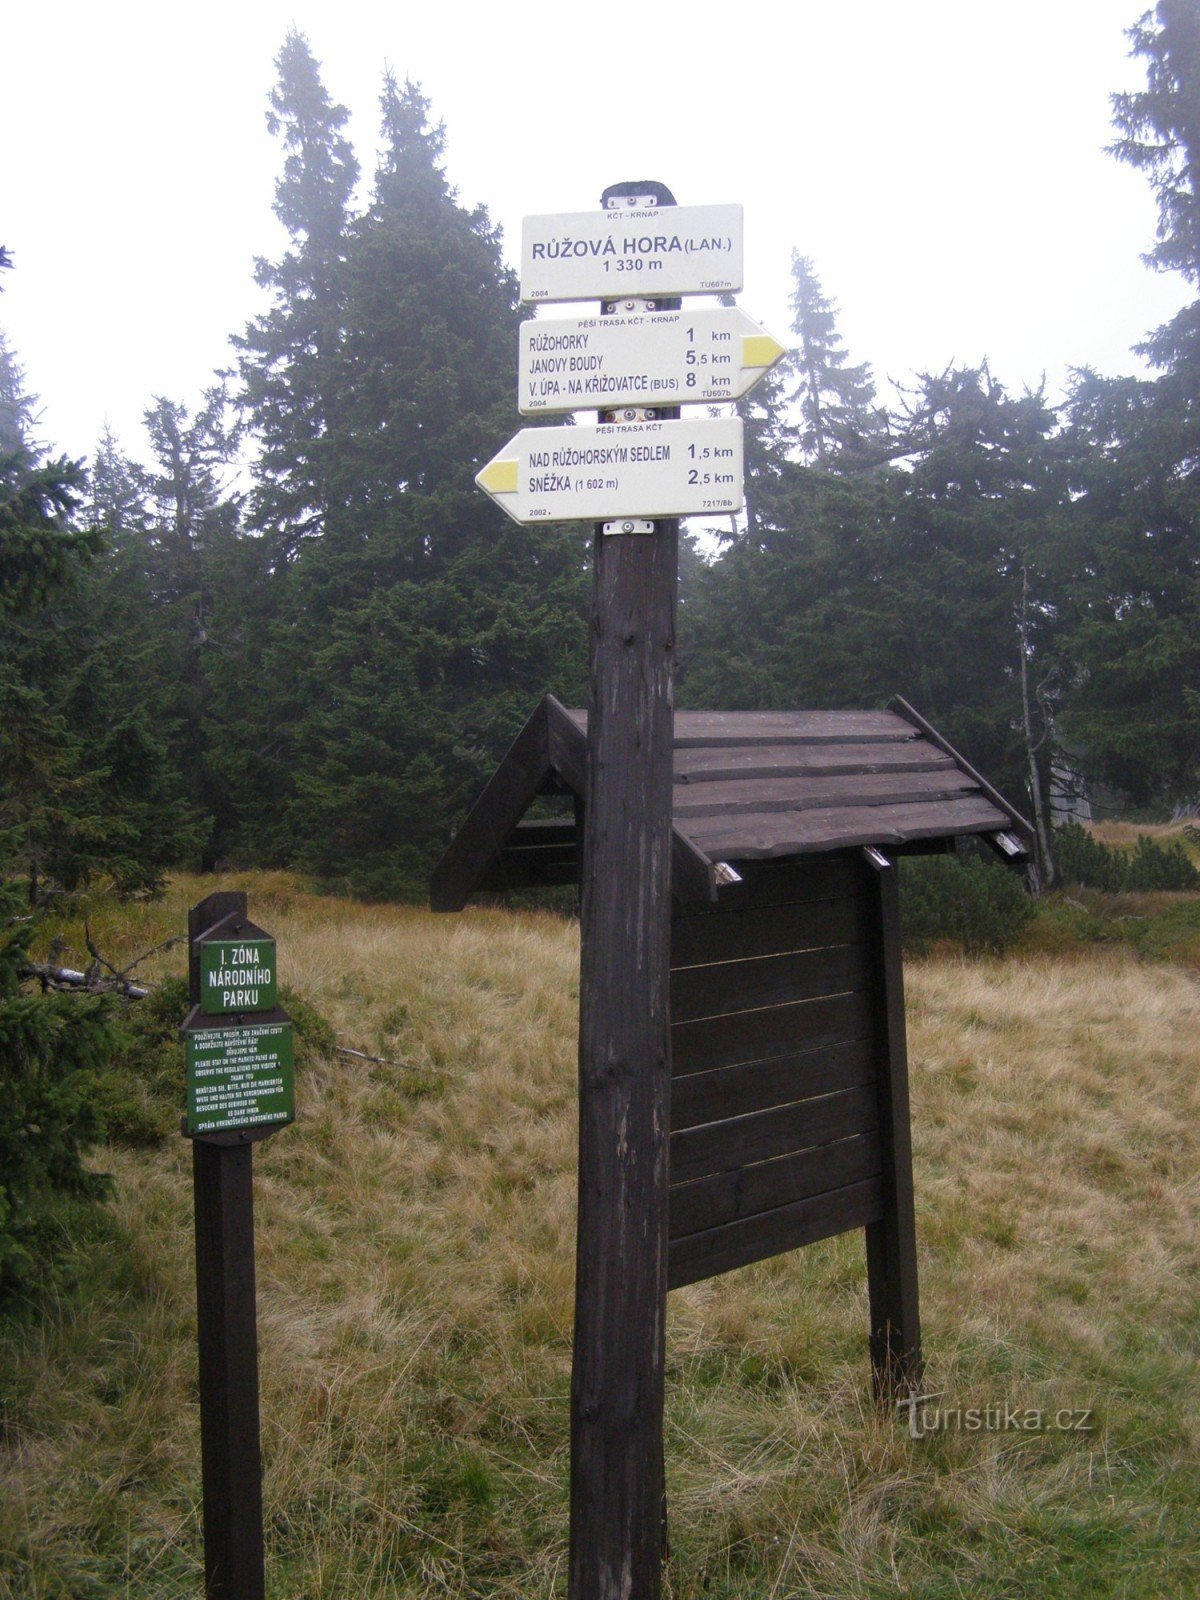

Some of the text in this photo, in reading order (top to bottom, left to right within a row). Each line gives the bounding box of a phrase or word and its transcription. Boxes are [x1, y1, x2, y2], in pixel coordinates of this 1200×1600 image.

[607, 212, 623, 220] KČT
[630, 211, 659, 219] KRNAP
[532, 235, 732, 260] RŮŽOVÁ HORA (LAN.)
[603, 258, 662, 272] 1 330 m
[530, 290, 549, 298] 2004
[577, 319, 597, 329] PĚŠÍ
[599, 318, 626, 327] TRASA
[628, 316, 644, 325] KČT
[651, 315, 680, 324] KRNAP
[529, 328, 731, 352] RŮŽOHORKY 1 km
[529, 350, 731, 375] JANOVY BOUDY 5,5 km
[529, 382, 538, 397] V.
[540, 378, 560, 396] ÚPA
[568, 379, 583, 394] NA
[585, 374, 648, 393] KŘIŽOVATCE
[650, 378, 679, 392] (BUS)
[686, 372, 696, 387] 8
[712, 374, 731, 387] km
[529, 400, 547, 408] 2004
[596, 422, 663, 434] PĚŠÍ TRASA KČT
[529, 443, 733, 468] NAD RŮŽOHORSKÝM SEDLEM 1,5 km
[529, 469, 734, 493] SNĚŽKA (1 602 m) 2,5 km
[221, 944, 260, 965] I. ZÓNA
[209, 965, 271, 987] NÁRODNÍHO
[223, 990, 259, 1007] PARKU
